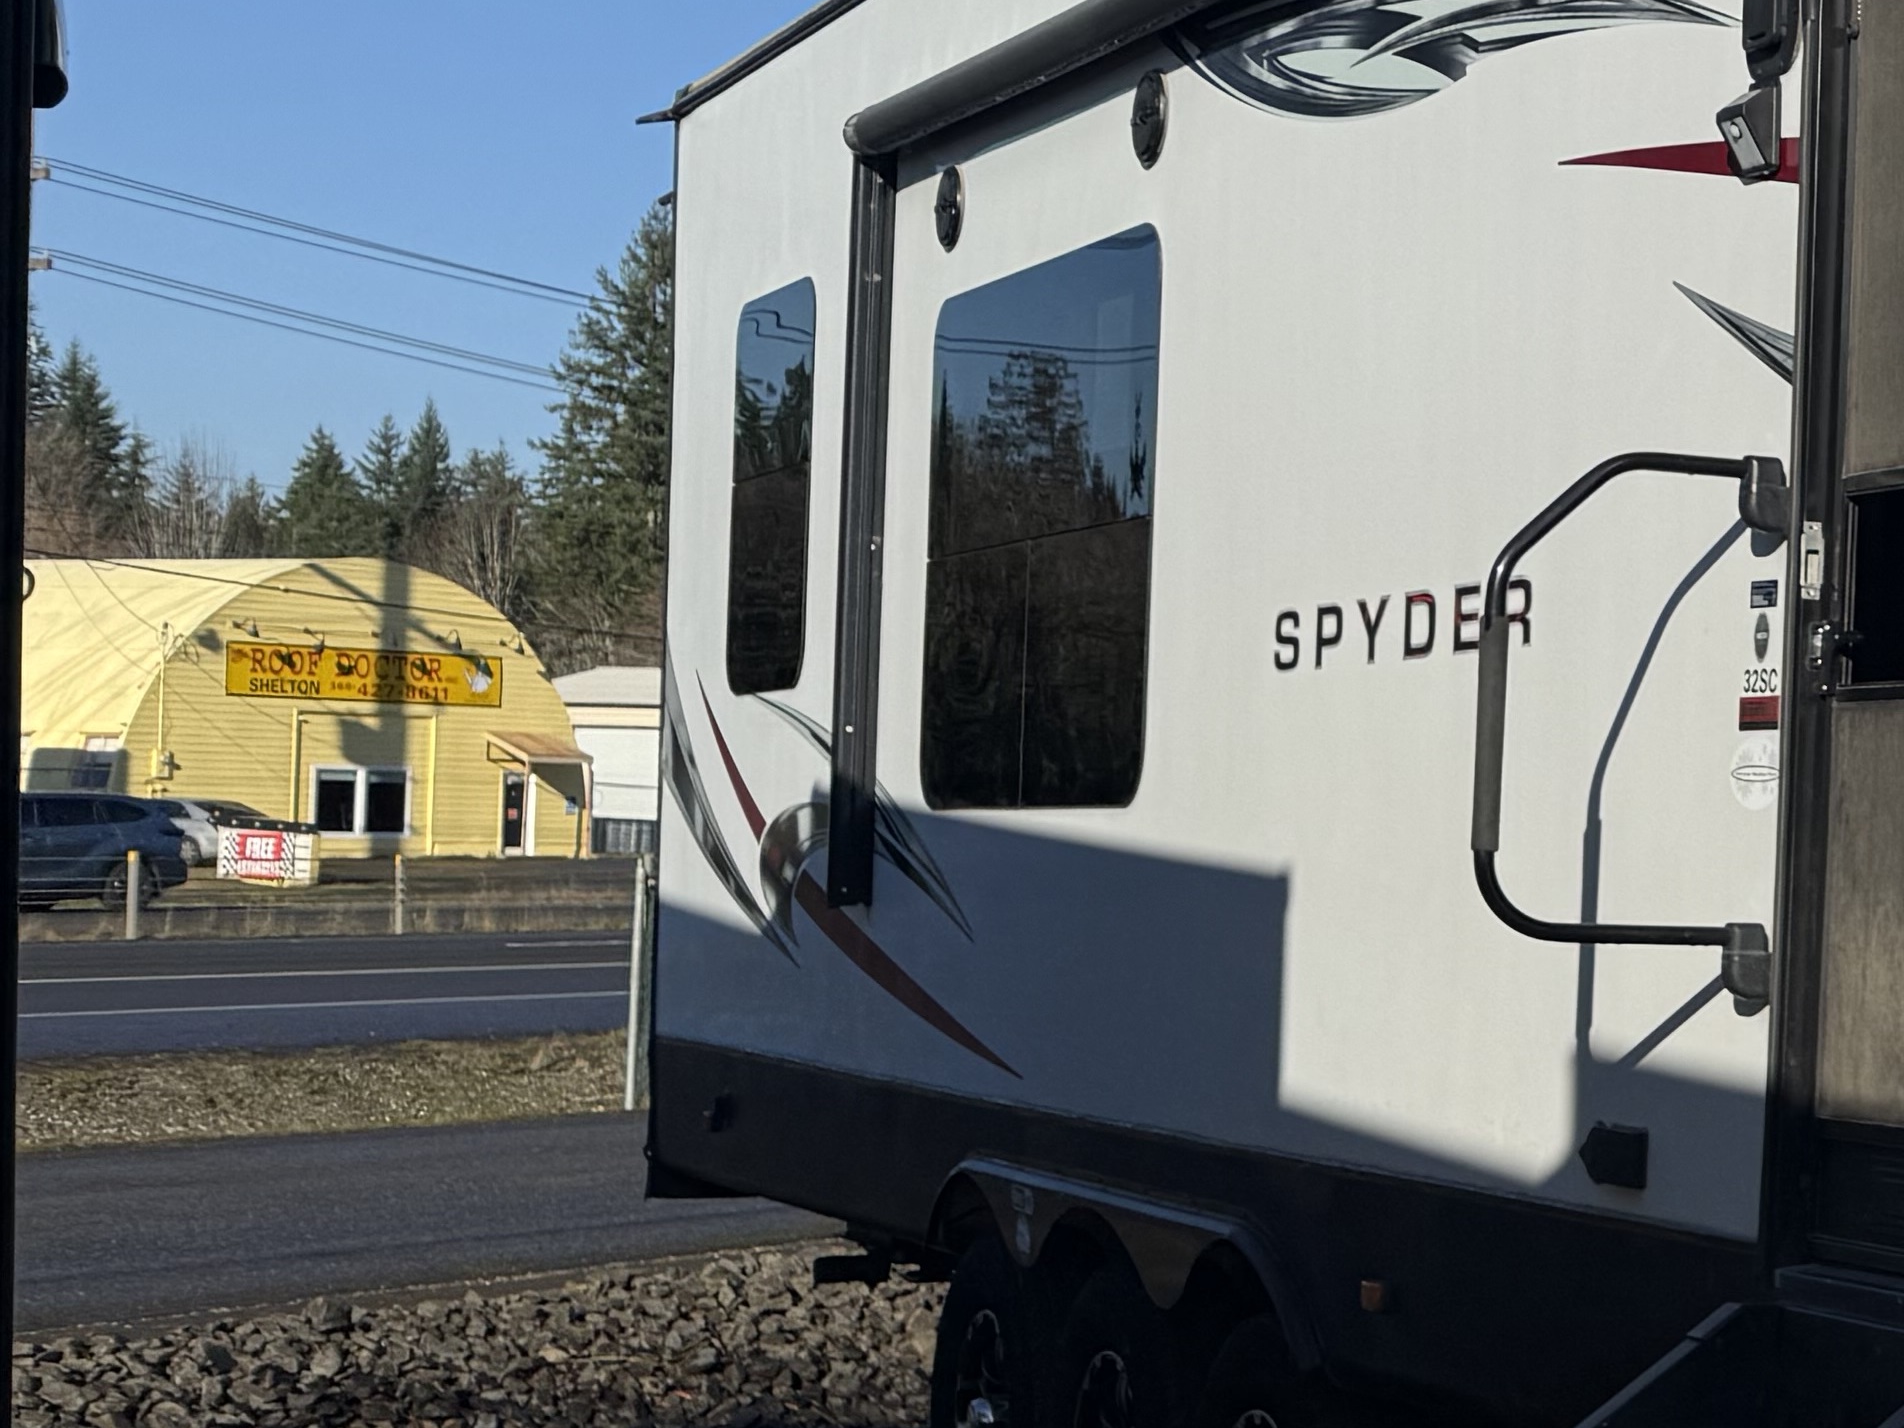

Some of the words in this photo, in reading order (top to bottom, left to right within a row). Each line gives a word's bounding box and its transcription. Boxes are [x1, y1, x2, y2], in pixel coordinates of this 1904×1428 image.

[1273, 574, 1533, 671] SPYDER
[250, 648, 321, 678] ROOF
[334, 652, 443, 683] DOCTOR
[1743, 668, 1778, 693] 32SC
[249, 677, 321, 696] SHELTON
